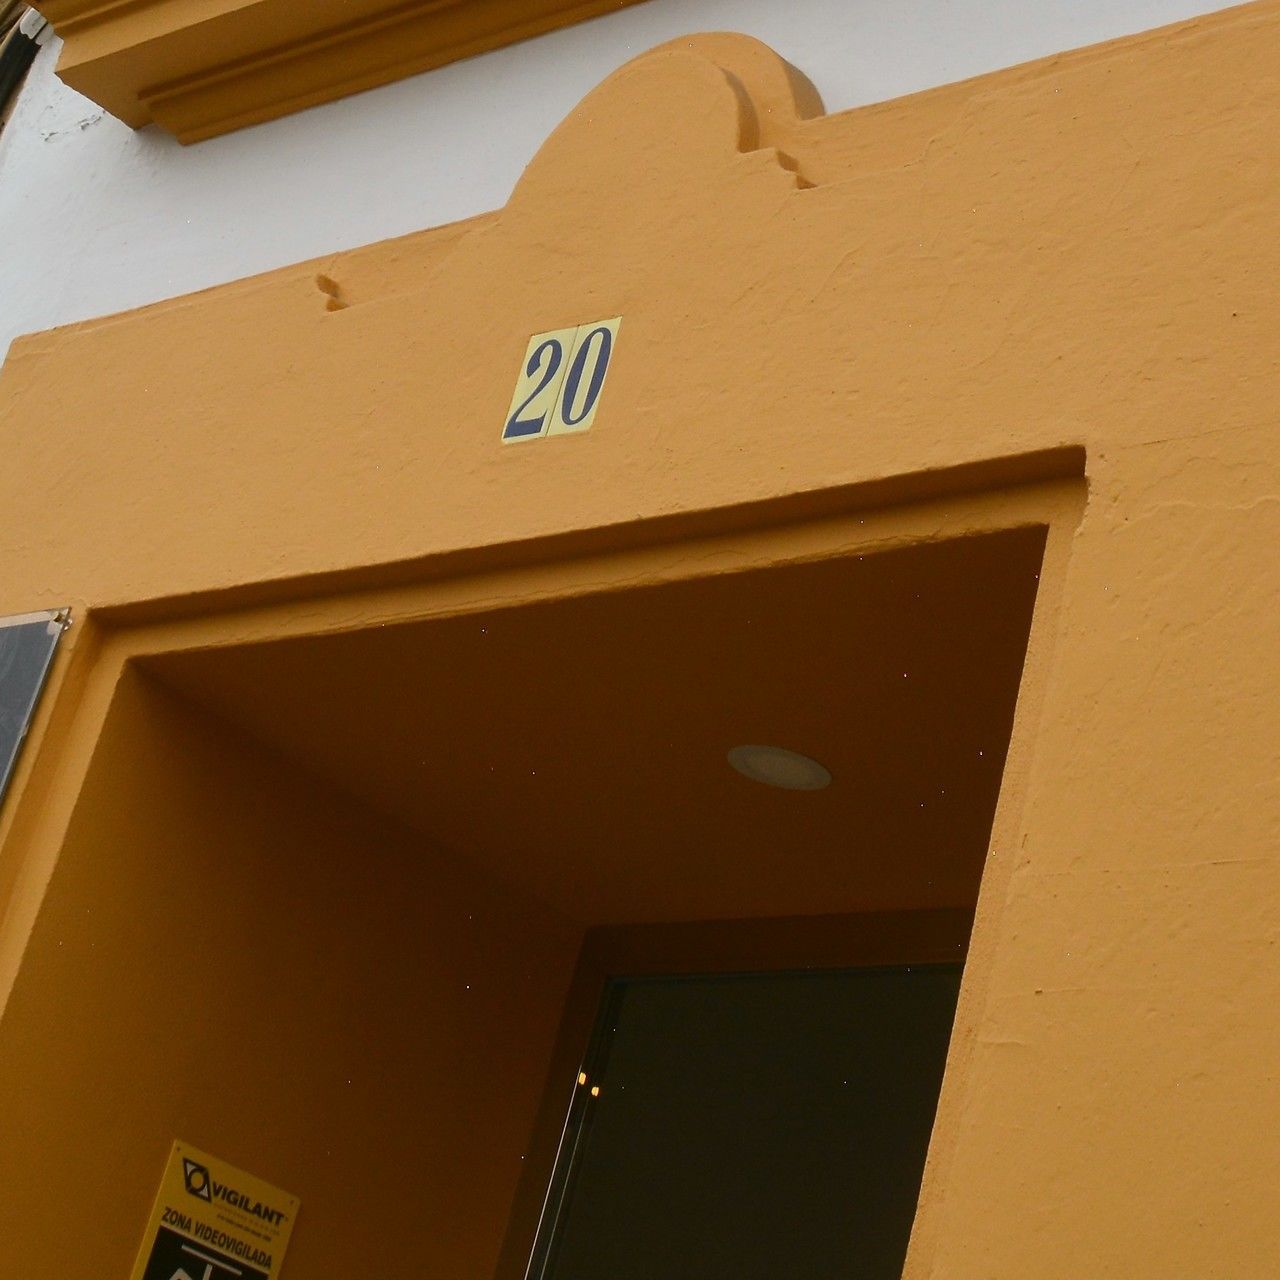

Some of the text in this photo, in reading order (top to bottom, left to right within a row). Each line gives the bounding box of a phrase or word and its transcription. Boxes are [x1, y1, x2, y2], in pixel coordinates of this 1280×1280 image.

[503, 327, 612, 439] 20
[212, 1181, 285, 1227] VIGILANT
[161, 1206, 193, 1233] ZONA
[194, 1220, 273, 1269] VIDEOVIGILADA
